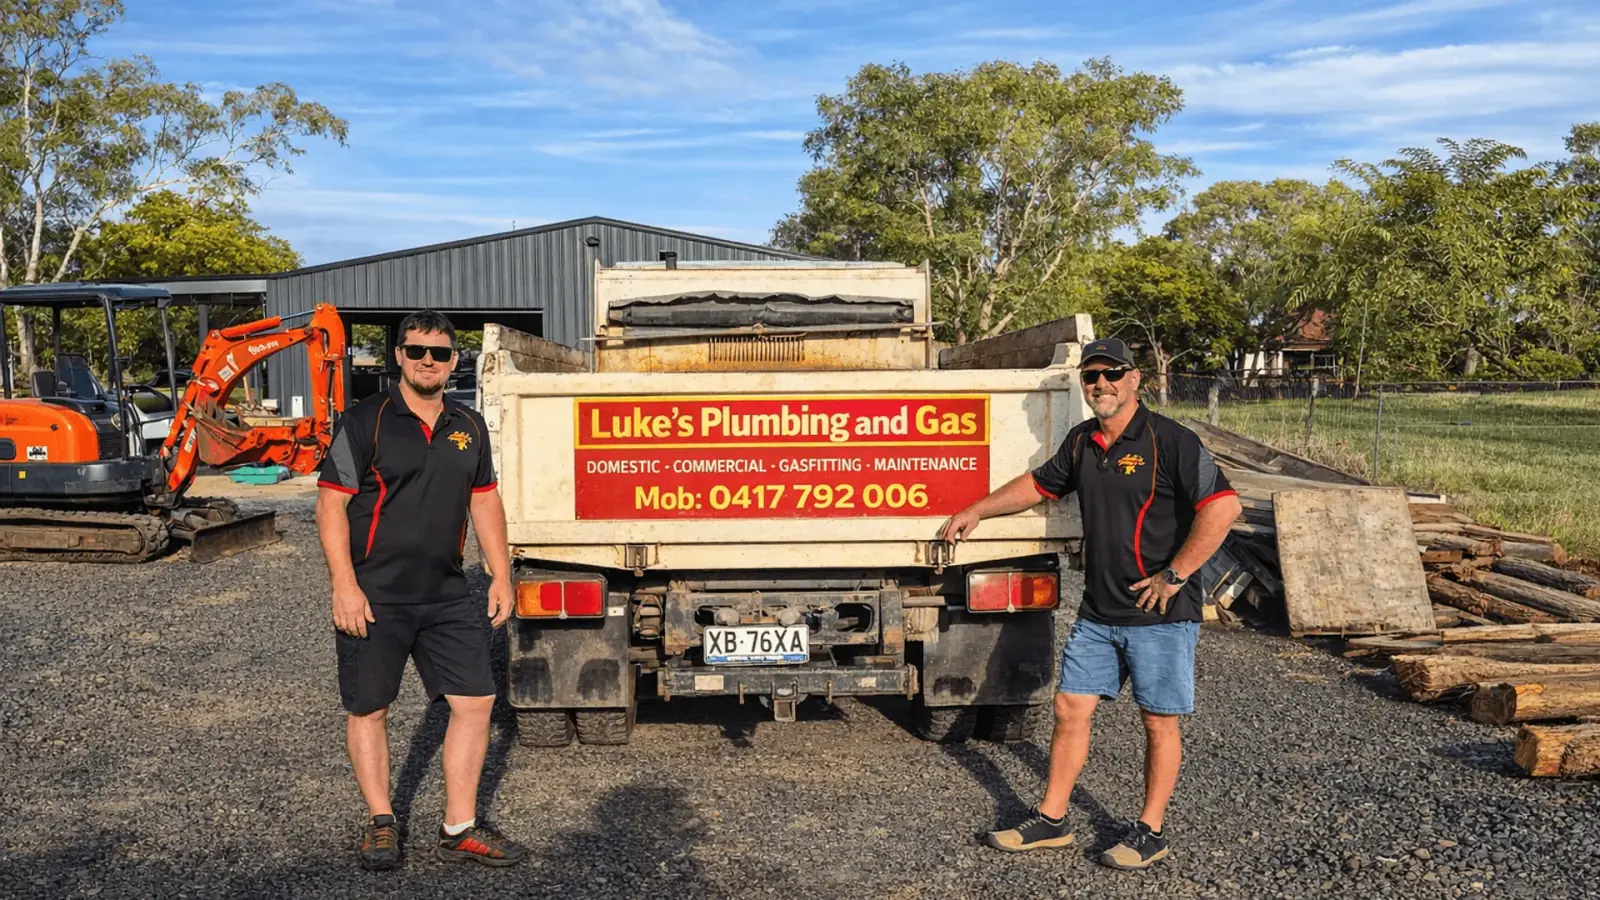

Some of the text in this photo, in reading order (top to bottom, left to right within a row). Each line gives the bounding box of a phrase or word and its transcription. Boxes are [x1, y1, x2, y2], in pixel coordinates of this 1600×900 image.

[701, 405, 850, 442] Plumbing
[854, 405, 908, 436] and
[914, 405, 978, 436] Gas
[586, 459, 661, 474] DOMESTIC
[672, 458, 767, 474] COMMERCIAL
[778, 457, 862, 473] GASFITTING
[874, 456, 977, 472] MAINTENANCE
[635, 483, 930, 511] Mob: 0417 792 006
